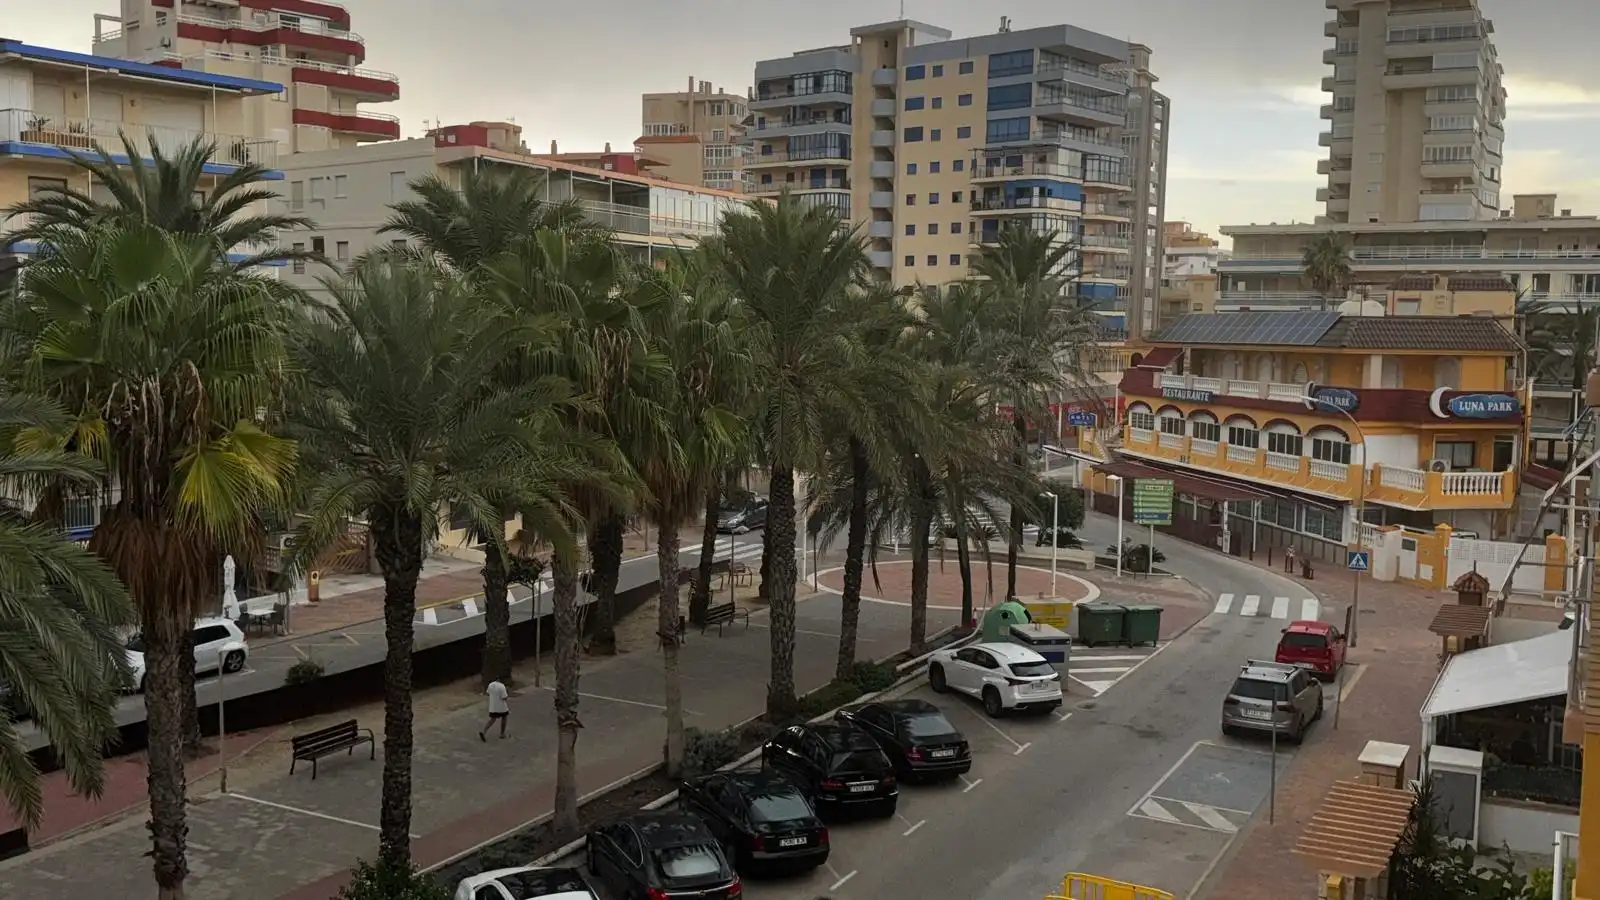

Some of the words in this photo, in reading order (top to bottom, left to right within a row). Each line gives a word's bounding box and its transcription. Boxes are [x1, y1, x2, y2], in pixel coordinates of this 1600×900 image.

[1162, 387, 1210, 402] RESTAURANTE
[1459, 401, 1485, 412] LUNA
[1487, 402, 1513, 412] PARK
